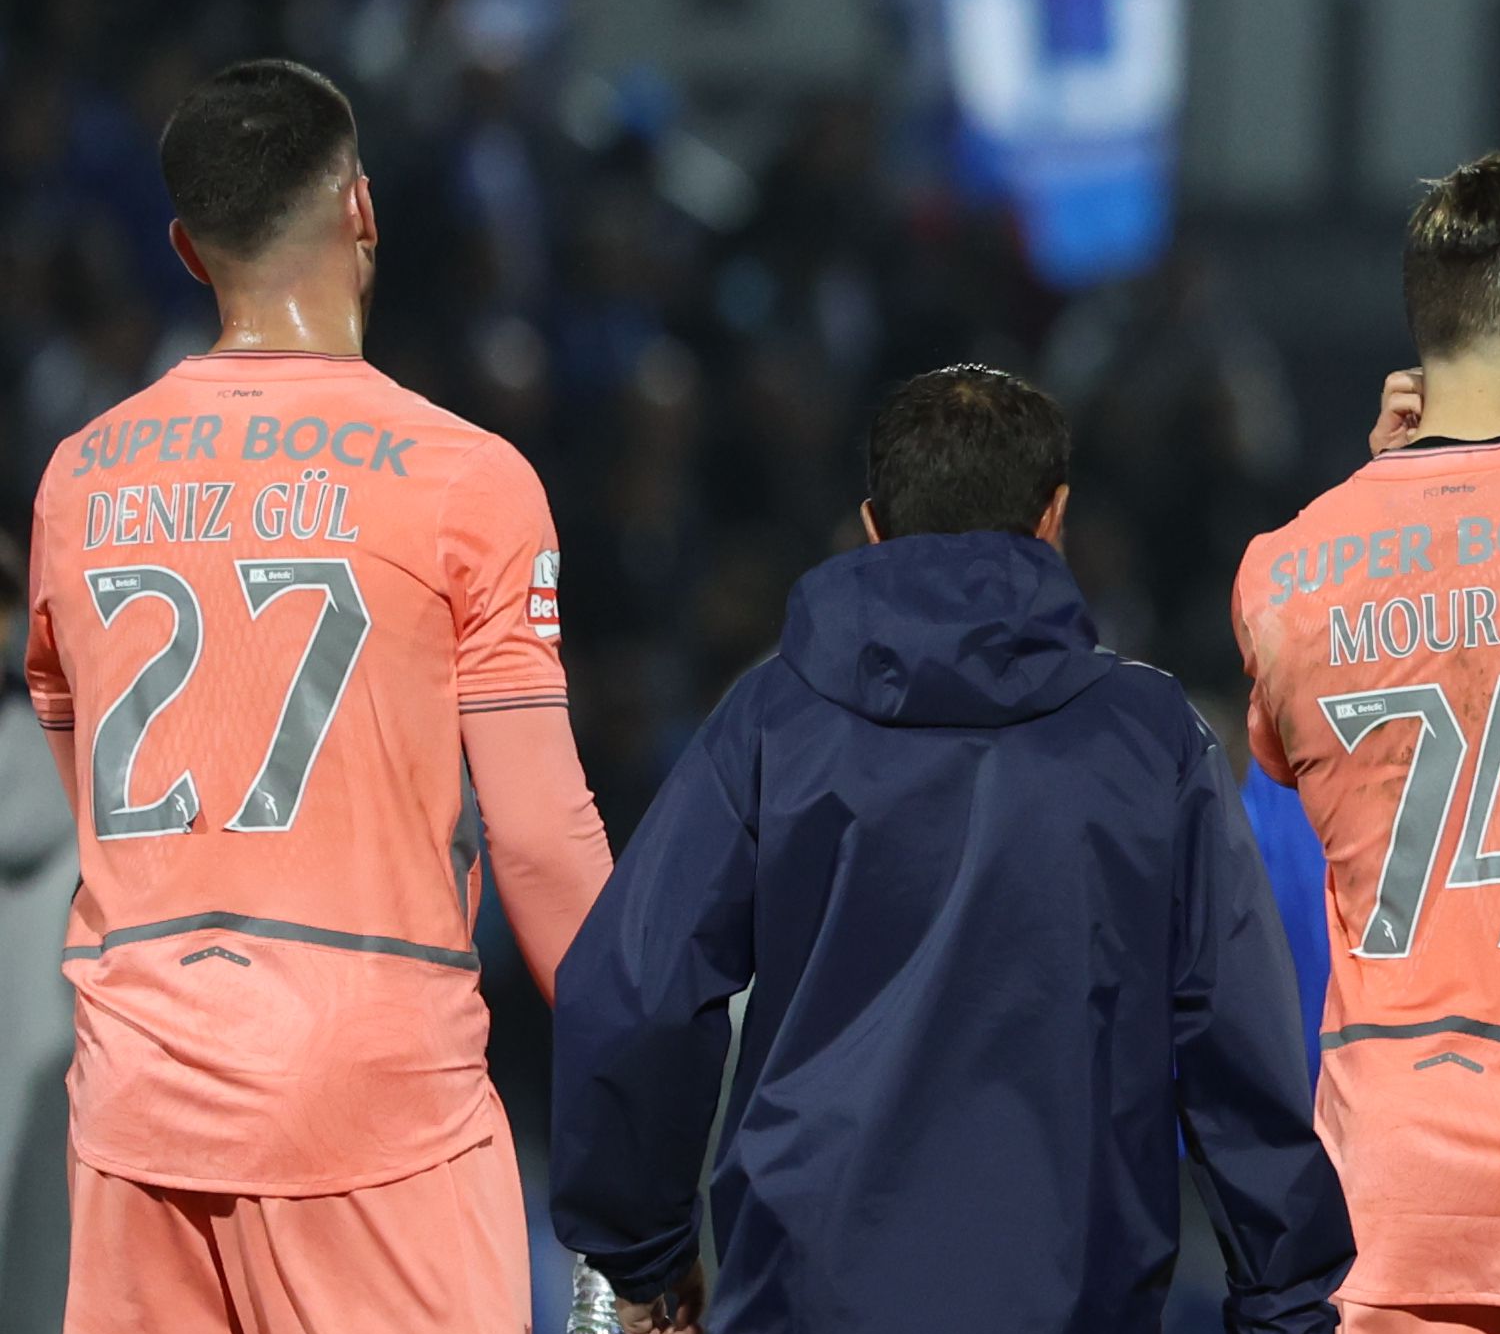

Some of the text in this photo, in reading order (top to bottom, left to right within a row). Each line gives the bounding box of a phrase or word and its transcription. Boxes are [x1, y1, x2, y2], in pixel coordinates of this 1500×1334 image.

[71, 414, 417, 478] SUPER BOCK
[84, 468, 360, 551] DENIZ GÜL
[1269, 524, 1431, 607] SUPER
[84, 558, 371, 841] 27
